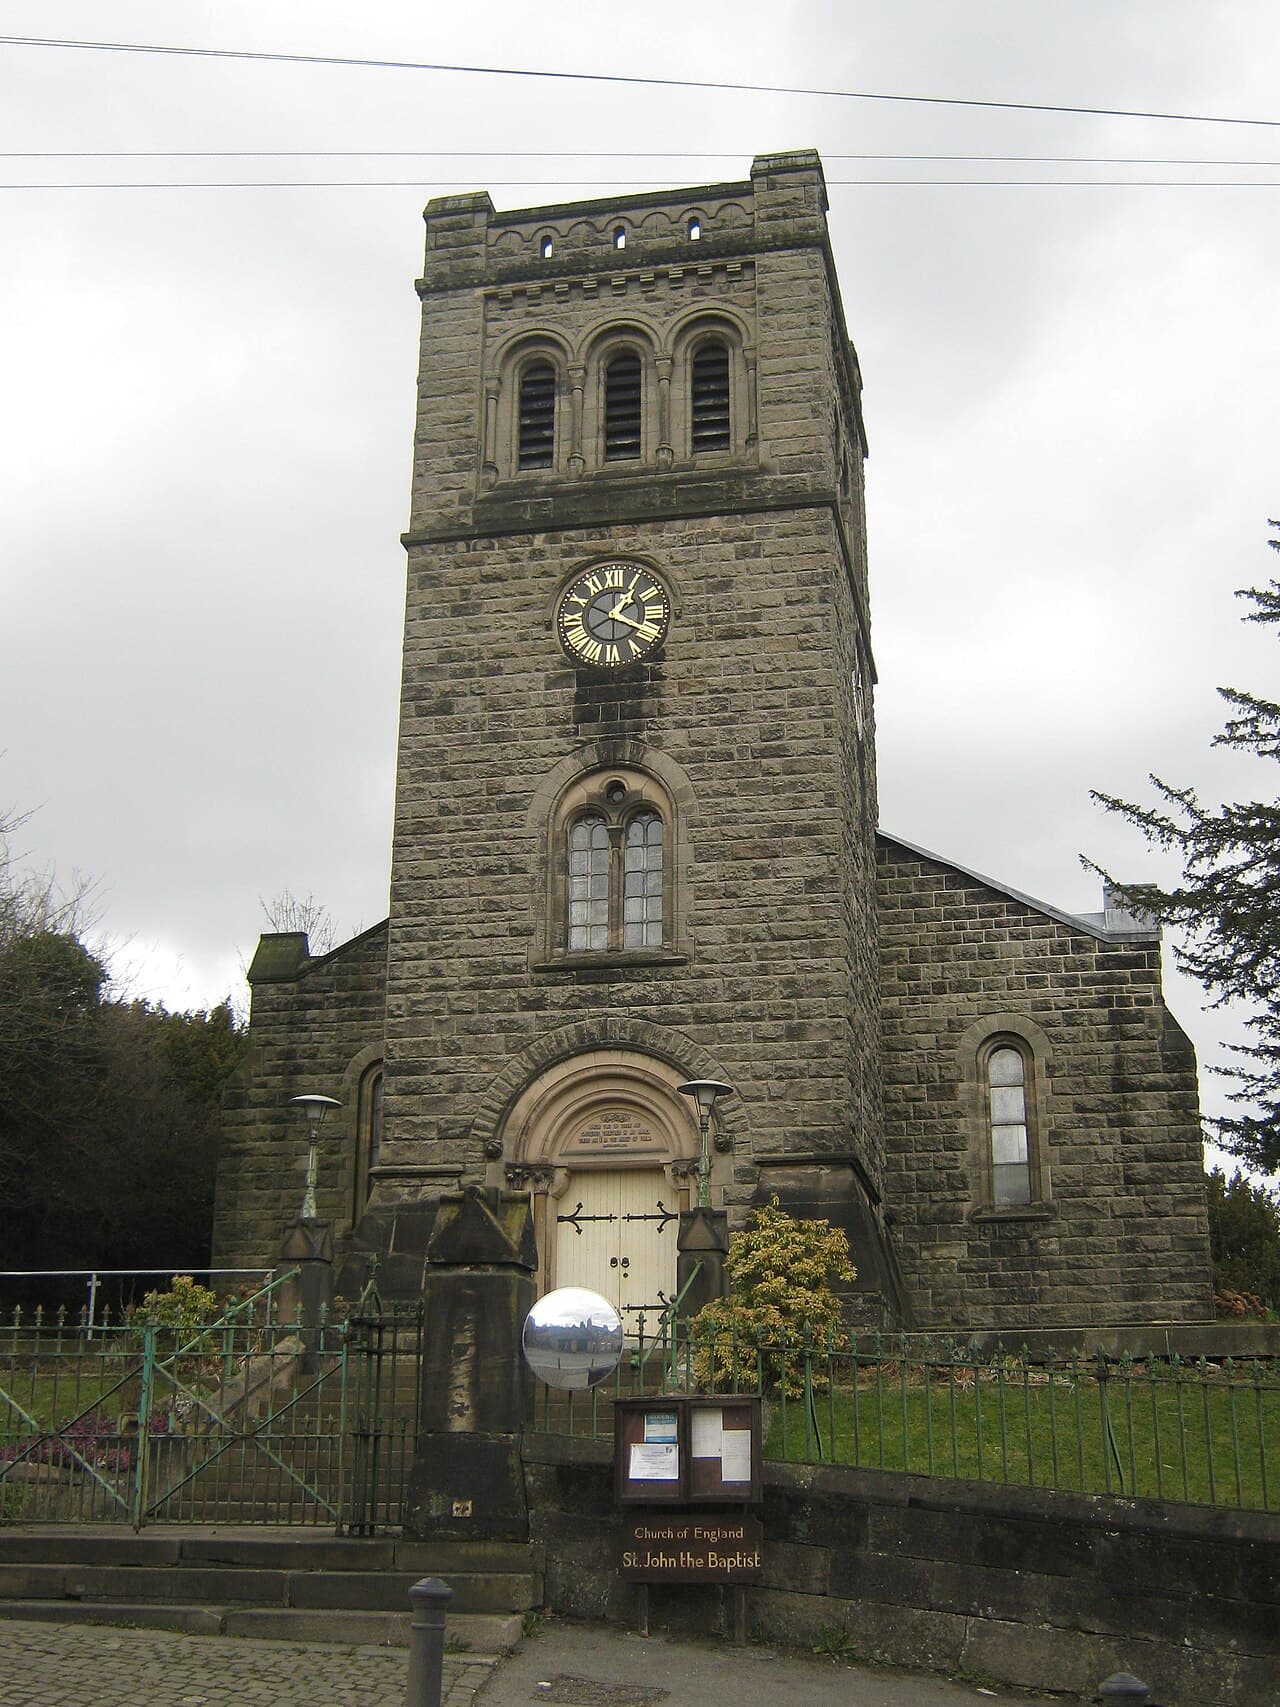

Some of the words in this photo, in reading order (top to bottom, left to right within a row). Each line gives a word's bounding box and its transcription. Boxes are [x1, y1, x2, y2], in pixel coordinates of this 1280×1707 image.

[584, 575, 604, 597] XI
[604, 569, 624, 589] XII
[628, 573, 641, 590] I
[569, 593, 589, 608] X
[639, 585, 659, 602] II
[563, 611, 583, 627] IX
[644, 604, 664, 619] III
[565, 625, 591, 651] VIII
[635, 620, 661, 643] III
[581, 639, 603, 661] VII
[605, 644, 621, 663] VI
[628, 639, 642, 656] V
[634, 1527, 674, 1539] Church
[677, 1527, 689, 1539] of
[694, 1527, 744, 1543] England
[680, 1551, 705, 1568] the
[708, 1551, 761, 1573] Baptist
